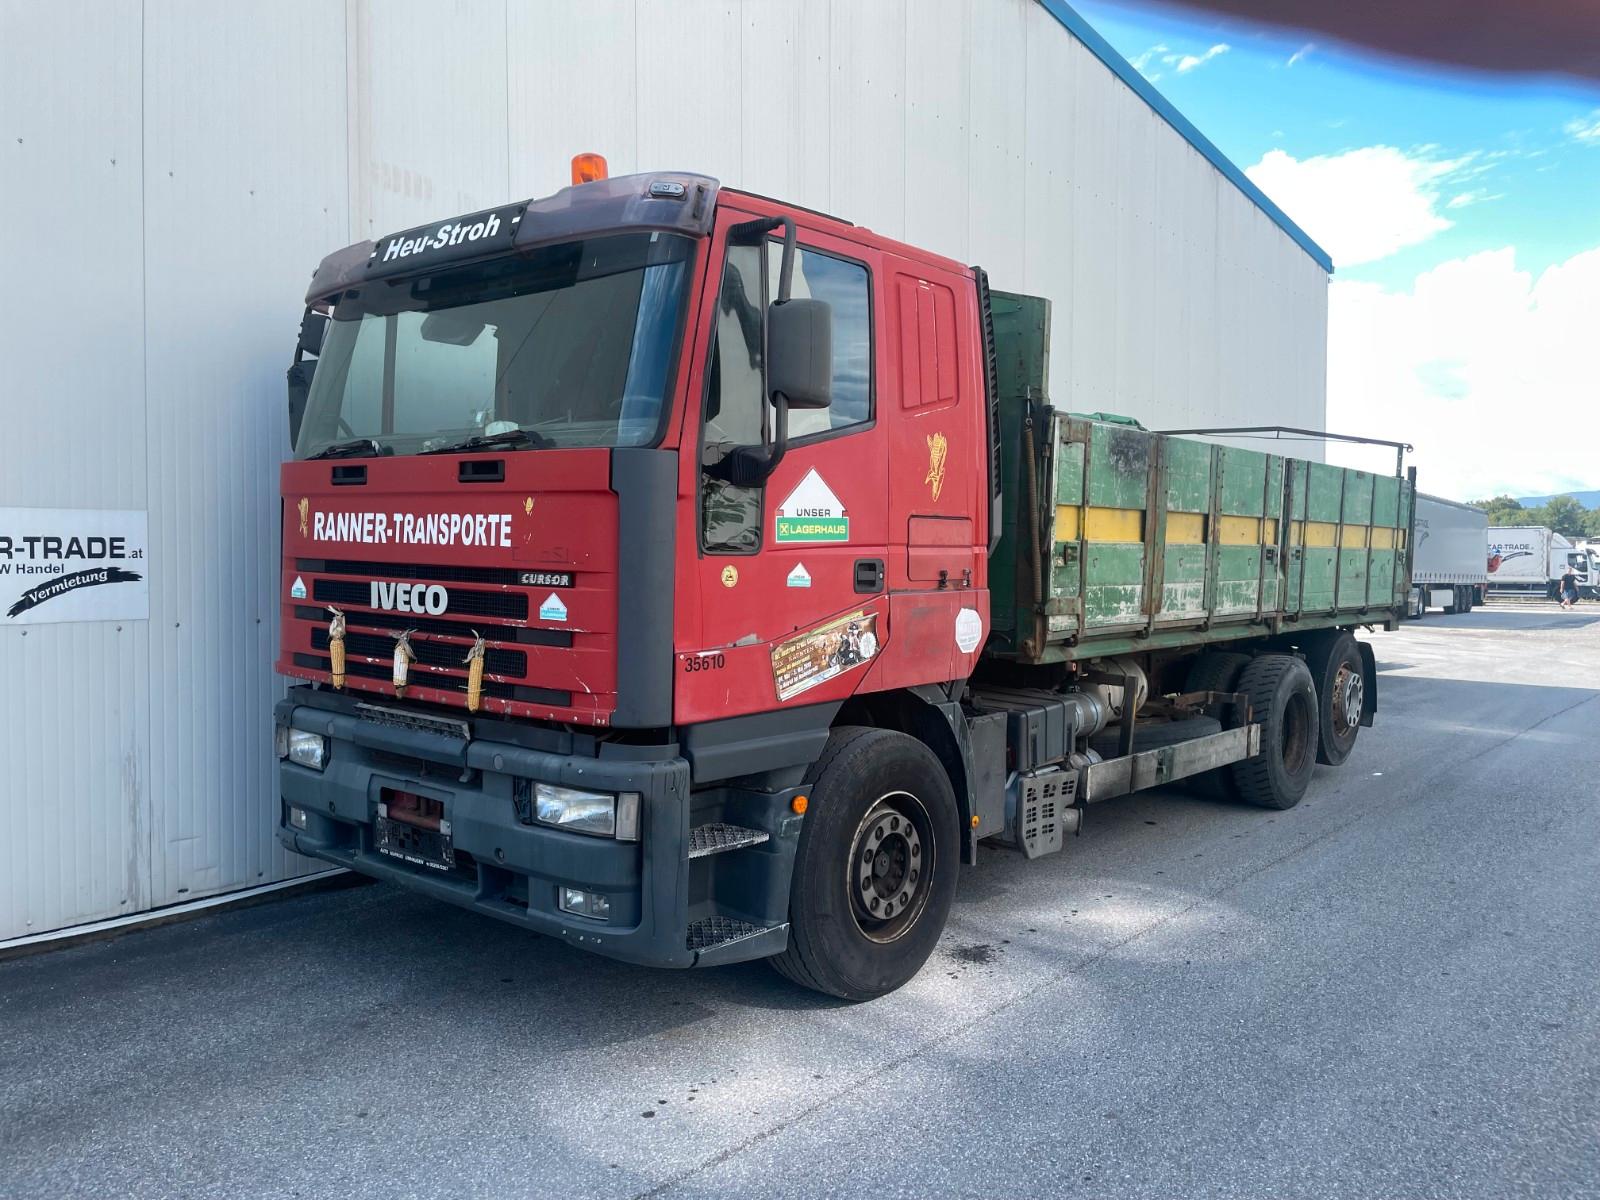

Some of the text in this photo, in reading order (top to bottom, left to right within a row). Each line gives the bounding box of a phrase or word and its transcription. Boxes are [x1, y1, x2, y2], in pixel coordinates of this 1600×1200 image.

[382, 213, 501, 262] Heu-Stroh
[796, 508, 831, 517] UNSER
[313, 511, 512, 547] RANNER-TRANSPORTE
[790, 524, 846, 535] LAGERHAUS
[16, 563, 65, 574] Handel
[29, 570, 108, 602] Vermietung
[521, 573, 569, 586] CURSOR
[370, 581, 448, 615] IVECO
[685, 653, 725, 672] 35610
